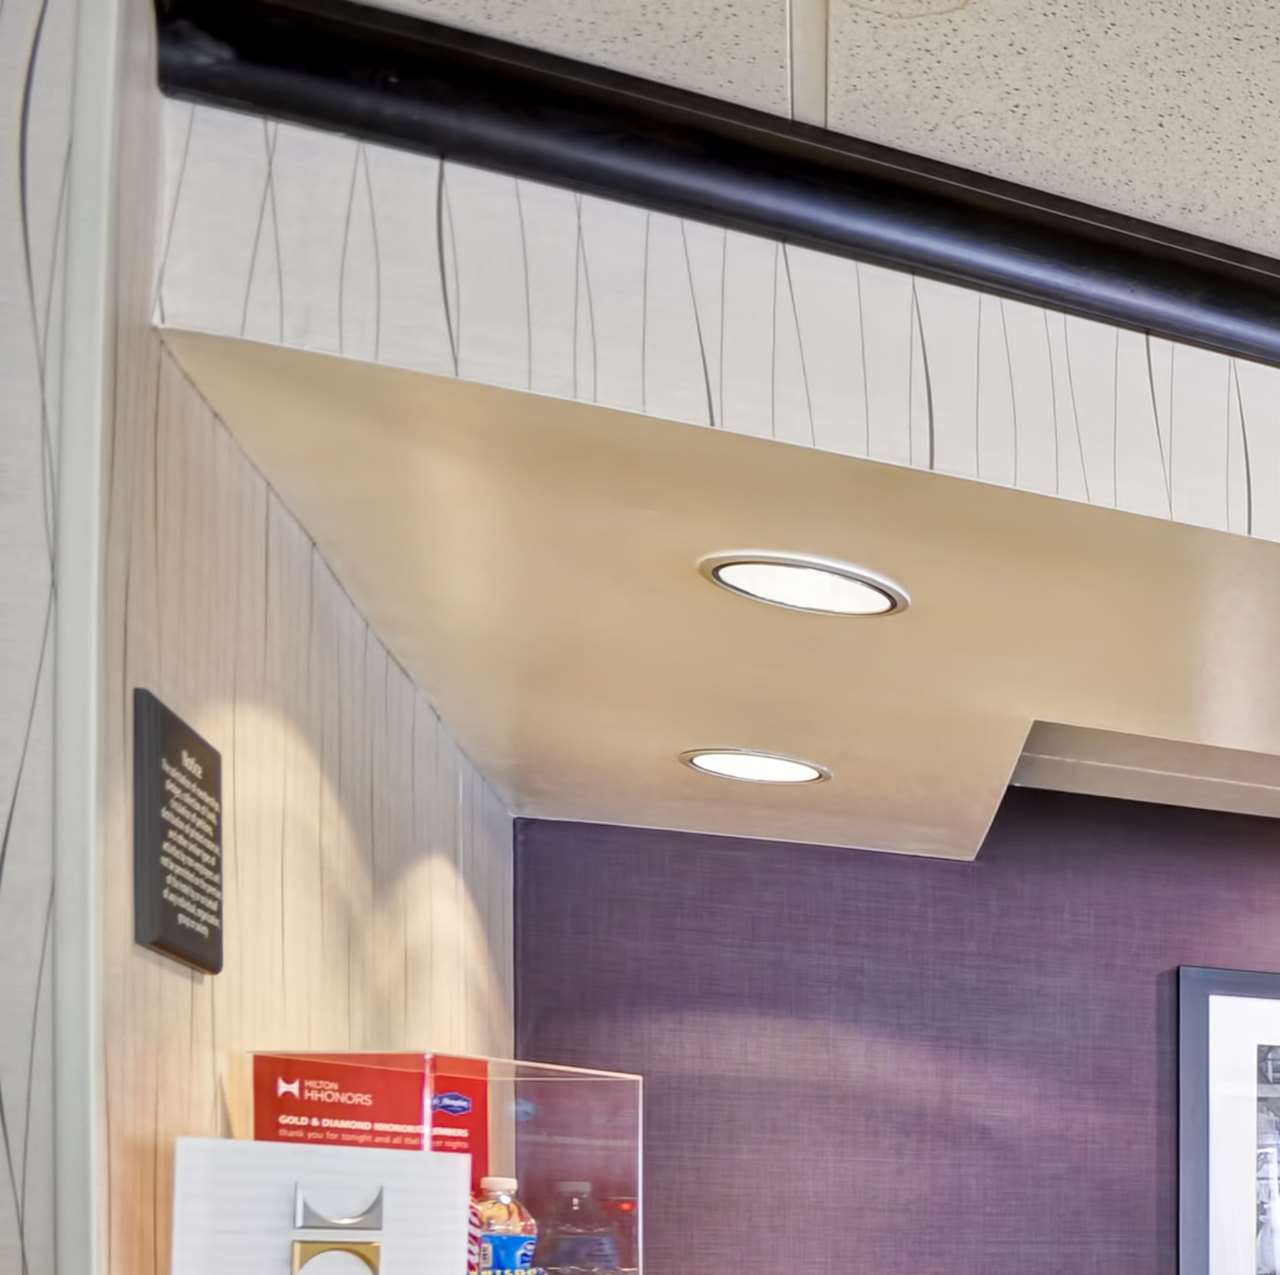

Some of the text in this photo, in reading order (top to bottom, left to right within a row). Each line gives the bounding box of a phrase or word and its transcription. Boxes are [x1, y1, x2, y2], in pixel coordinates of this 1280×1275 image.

[304, 1080, 339, 1090] HILTON
[304, 1089, 373, 1106] HHONORS
[278, 1115, 309, 1126] GOLD
[310, 1118, 320, 1127] &
[321, 1118, 372, 1131] DIAMOND
[306, 1131, 324, 1140] you
